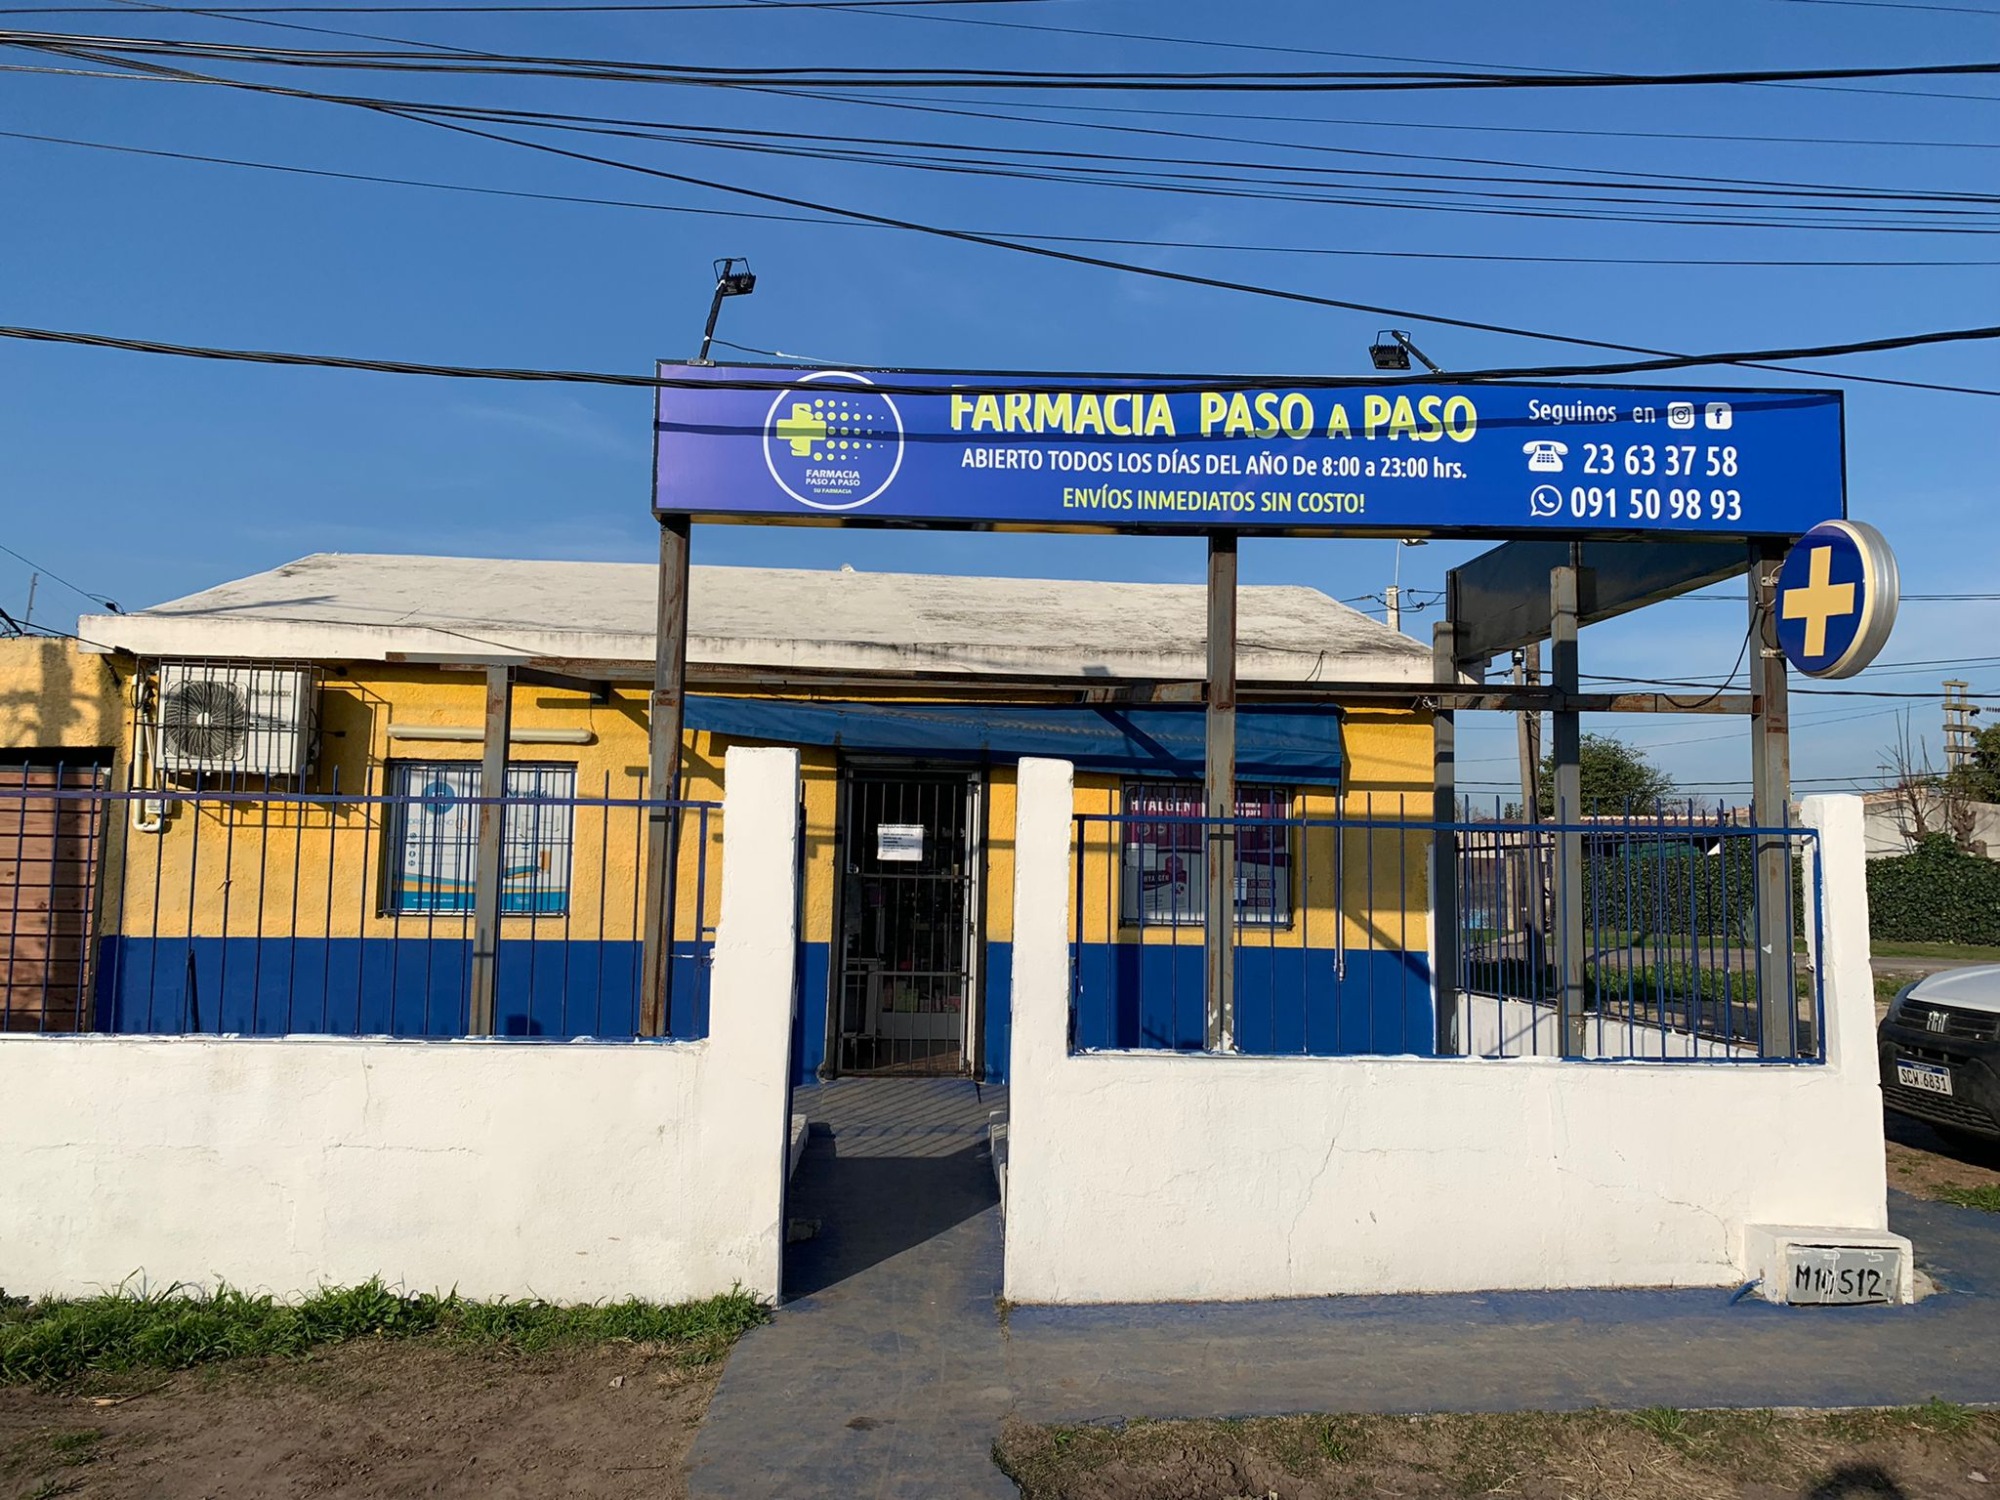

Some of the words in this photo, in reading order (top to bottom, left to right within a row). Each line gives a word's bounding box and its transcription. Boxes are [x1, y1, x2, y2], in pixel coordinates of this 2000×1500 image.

[951, 384, 1176, 437] FARMACIA
[1200, 391, 1314, 440] PASO
[1326, 404, 1352, 440] A
[1364, 394, 1477, 443] PASO
[1528, 399, 1617, 425] Seguinos
[1632, 406, 1656, 423] en
[806, 469, 860, 479] FARMACIA
[961, 448, 1043, 470] ABIERTO
[1048, 450, 1113, 472] TODOS
[1118, 452, 1152, 473] LOS
[1158, 449, 1200, 474] DÍAS
[1206, 455, 1241, 475] DEL
[1245, 451, 1288, 475] AÑO
[1293, 456, 1316, 475] De
[1322, 456, 1360, 477] 8:00
[1365, 461, 1375, 477] a
[1380, 457, 1428, 478] 23:00
[1433, 456, 1467, 478] hrs.
[1583, 443, 1616, 475] 23
[1624, 445, 1656, 476] 63
[1665, 445, 1697, 476] 37
[1706, 446, 1738, 477] 58
[1063, 484, 1133, 509] ENVÍOS
[1137, 490, 1255, 512] INMEDIATOS
[1261, 492, 1291, 512] SIN
[1297, 493, 1365, 513] COSTO!
[1570, 487, 1617, 518] 091
[1628, 489, 1660, 520] 50
[1669, 489, 1701, 520] 98
[1710, 490, 1742, 520] 93
[1923, 1073, 1947, 1091] 6831
